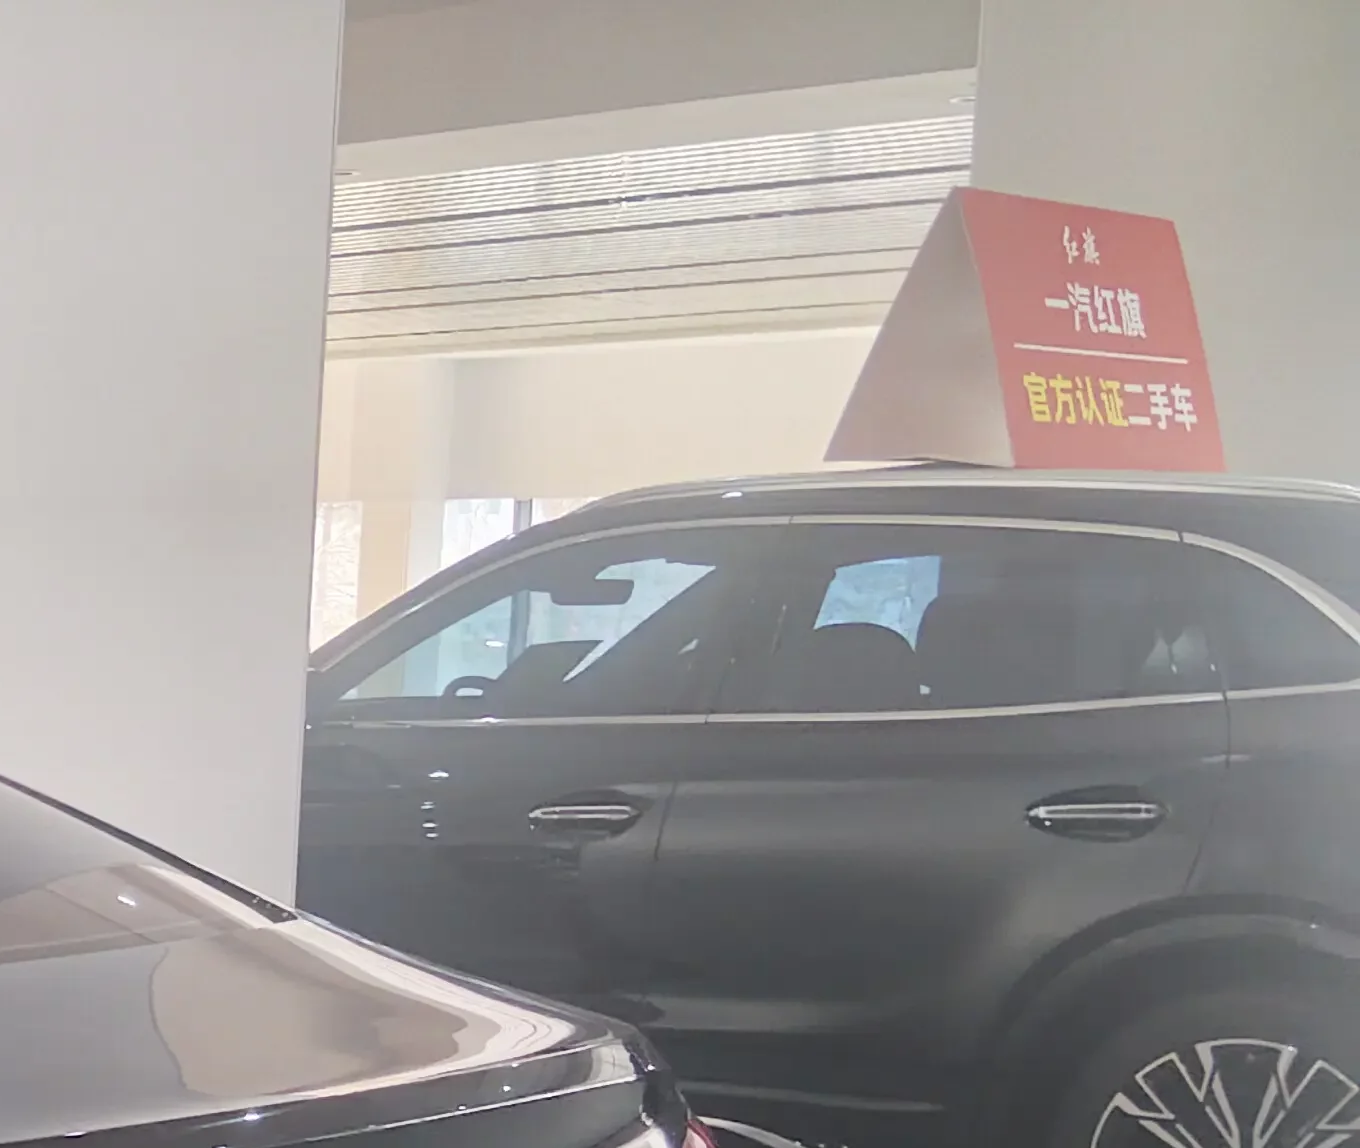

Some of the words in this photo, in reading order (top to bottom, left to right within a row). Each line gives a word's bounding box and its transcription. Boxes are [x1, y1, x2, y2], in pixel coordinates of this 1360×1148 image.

[1063, 225, 1100, 265] 红旗
[1045, 282, 1147, 339] 一汽红旗
[1023, 372, 1197, 432] 官方认证二手车
